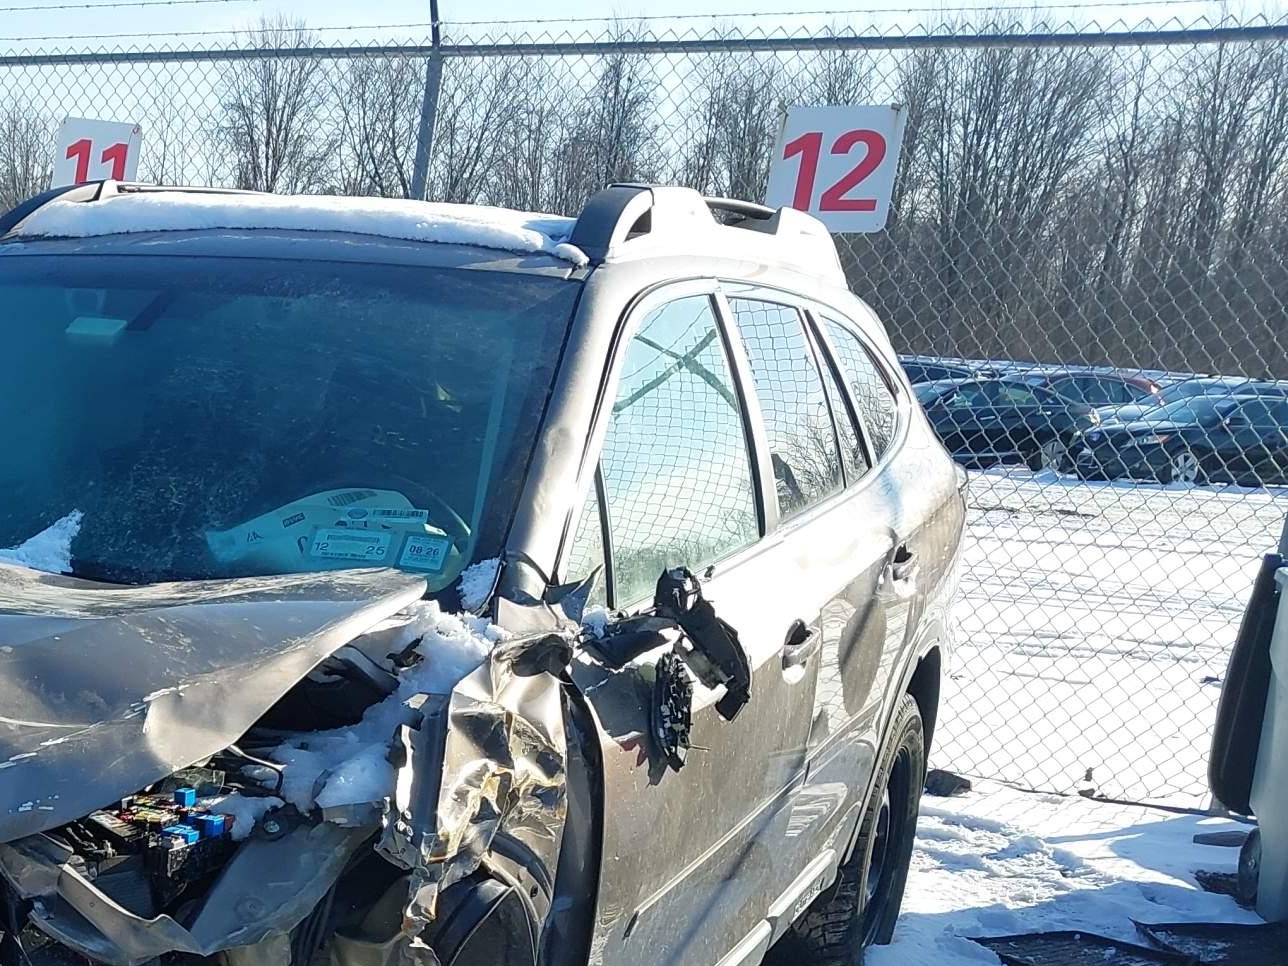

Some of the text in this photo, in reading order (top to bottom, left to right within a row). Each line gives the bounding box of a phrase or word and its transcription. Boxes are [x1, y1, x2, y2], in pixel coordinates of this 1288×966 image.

[65, 138, 128, 185] 11
[783, 129, 887, 212] 12
[366, 545, 385, 555] 25
[409, 544, 440, 556] 08 26
